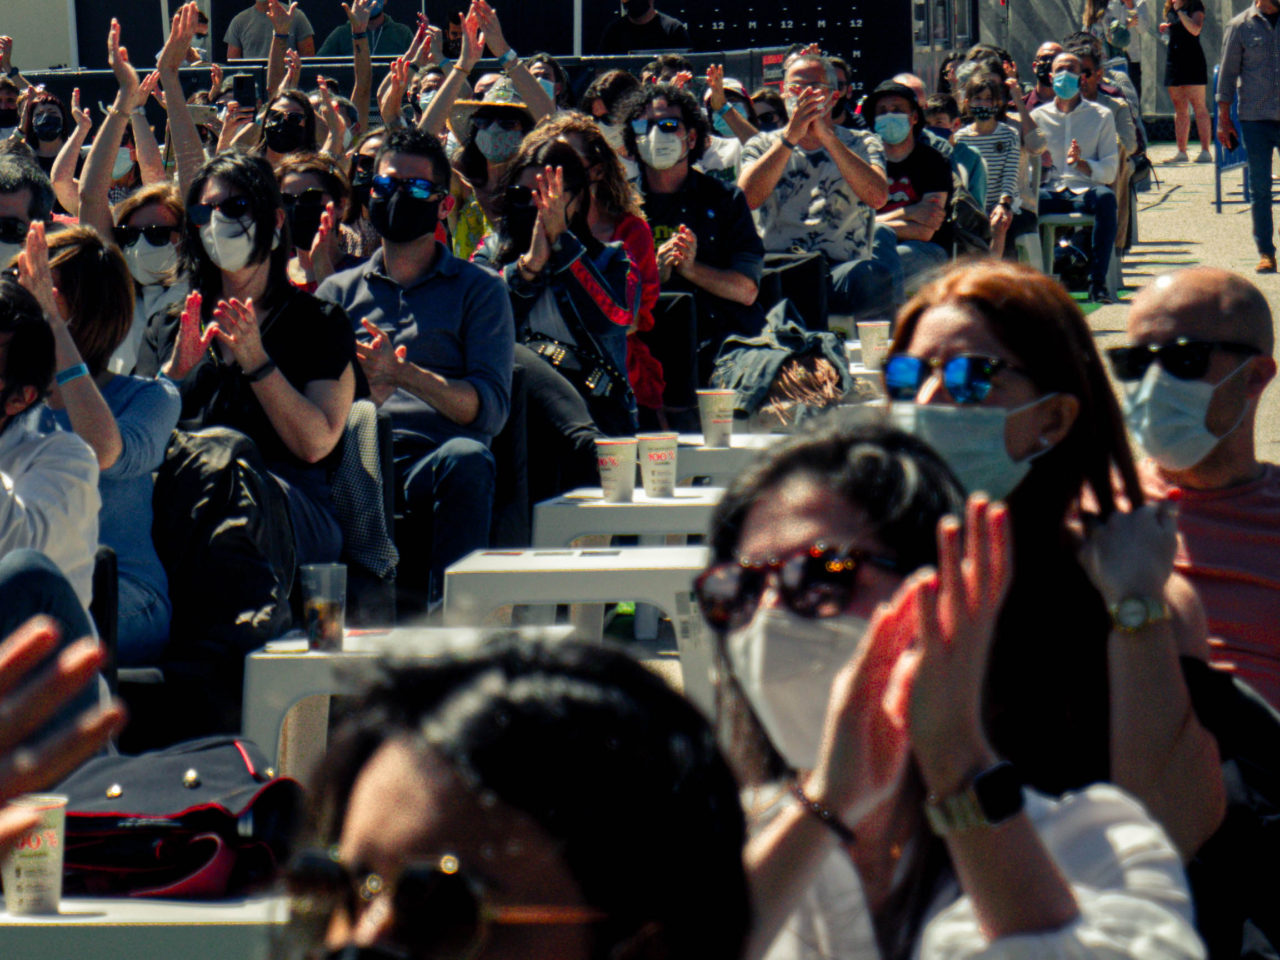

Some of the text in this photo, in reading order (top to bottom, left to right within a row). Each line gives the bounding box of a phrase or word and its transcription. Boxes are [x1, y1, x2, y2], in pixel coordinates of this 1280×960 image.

[712, 21, 725, 30] 12
[749, 21, 757, 29] M
[780, 20, 794, 29] 12
[818, 19, 826, 28] M
[850, 19, 863, 28] 12
[853, 50, 861, 58] M
